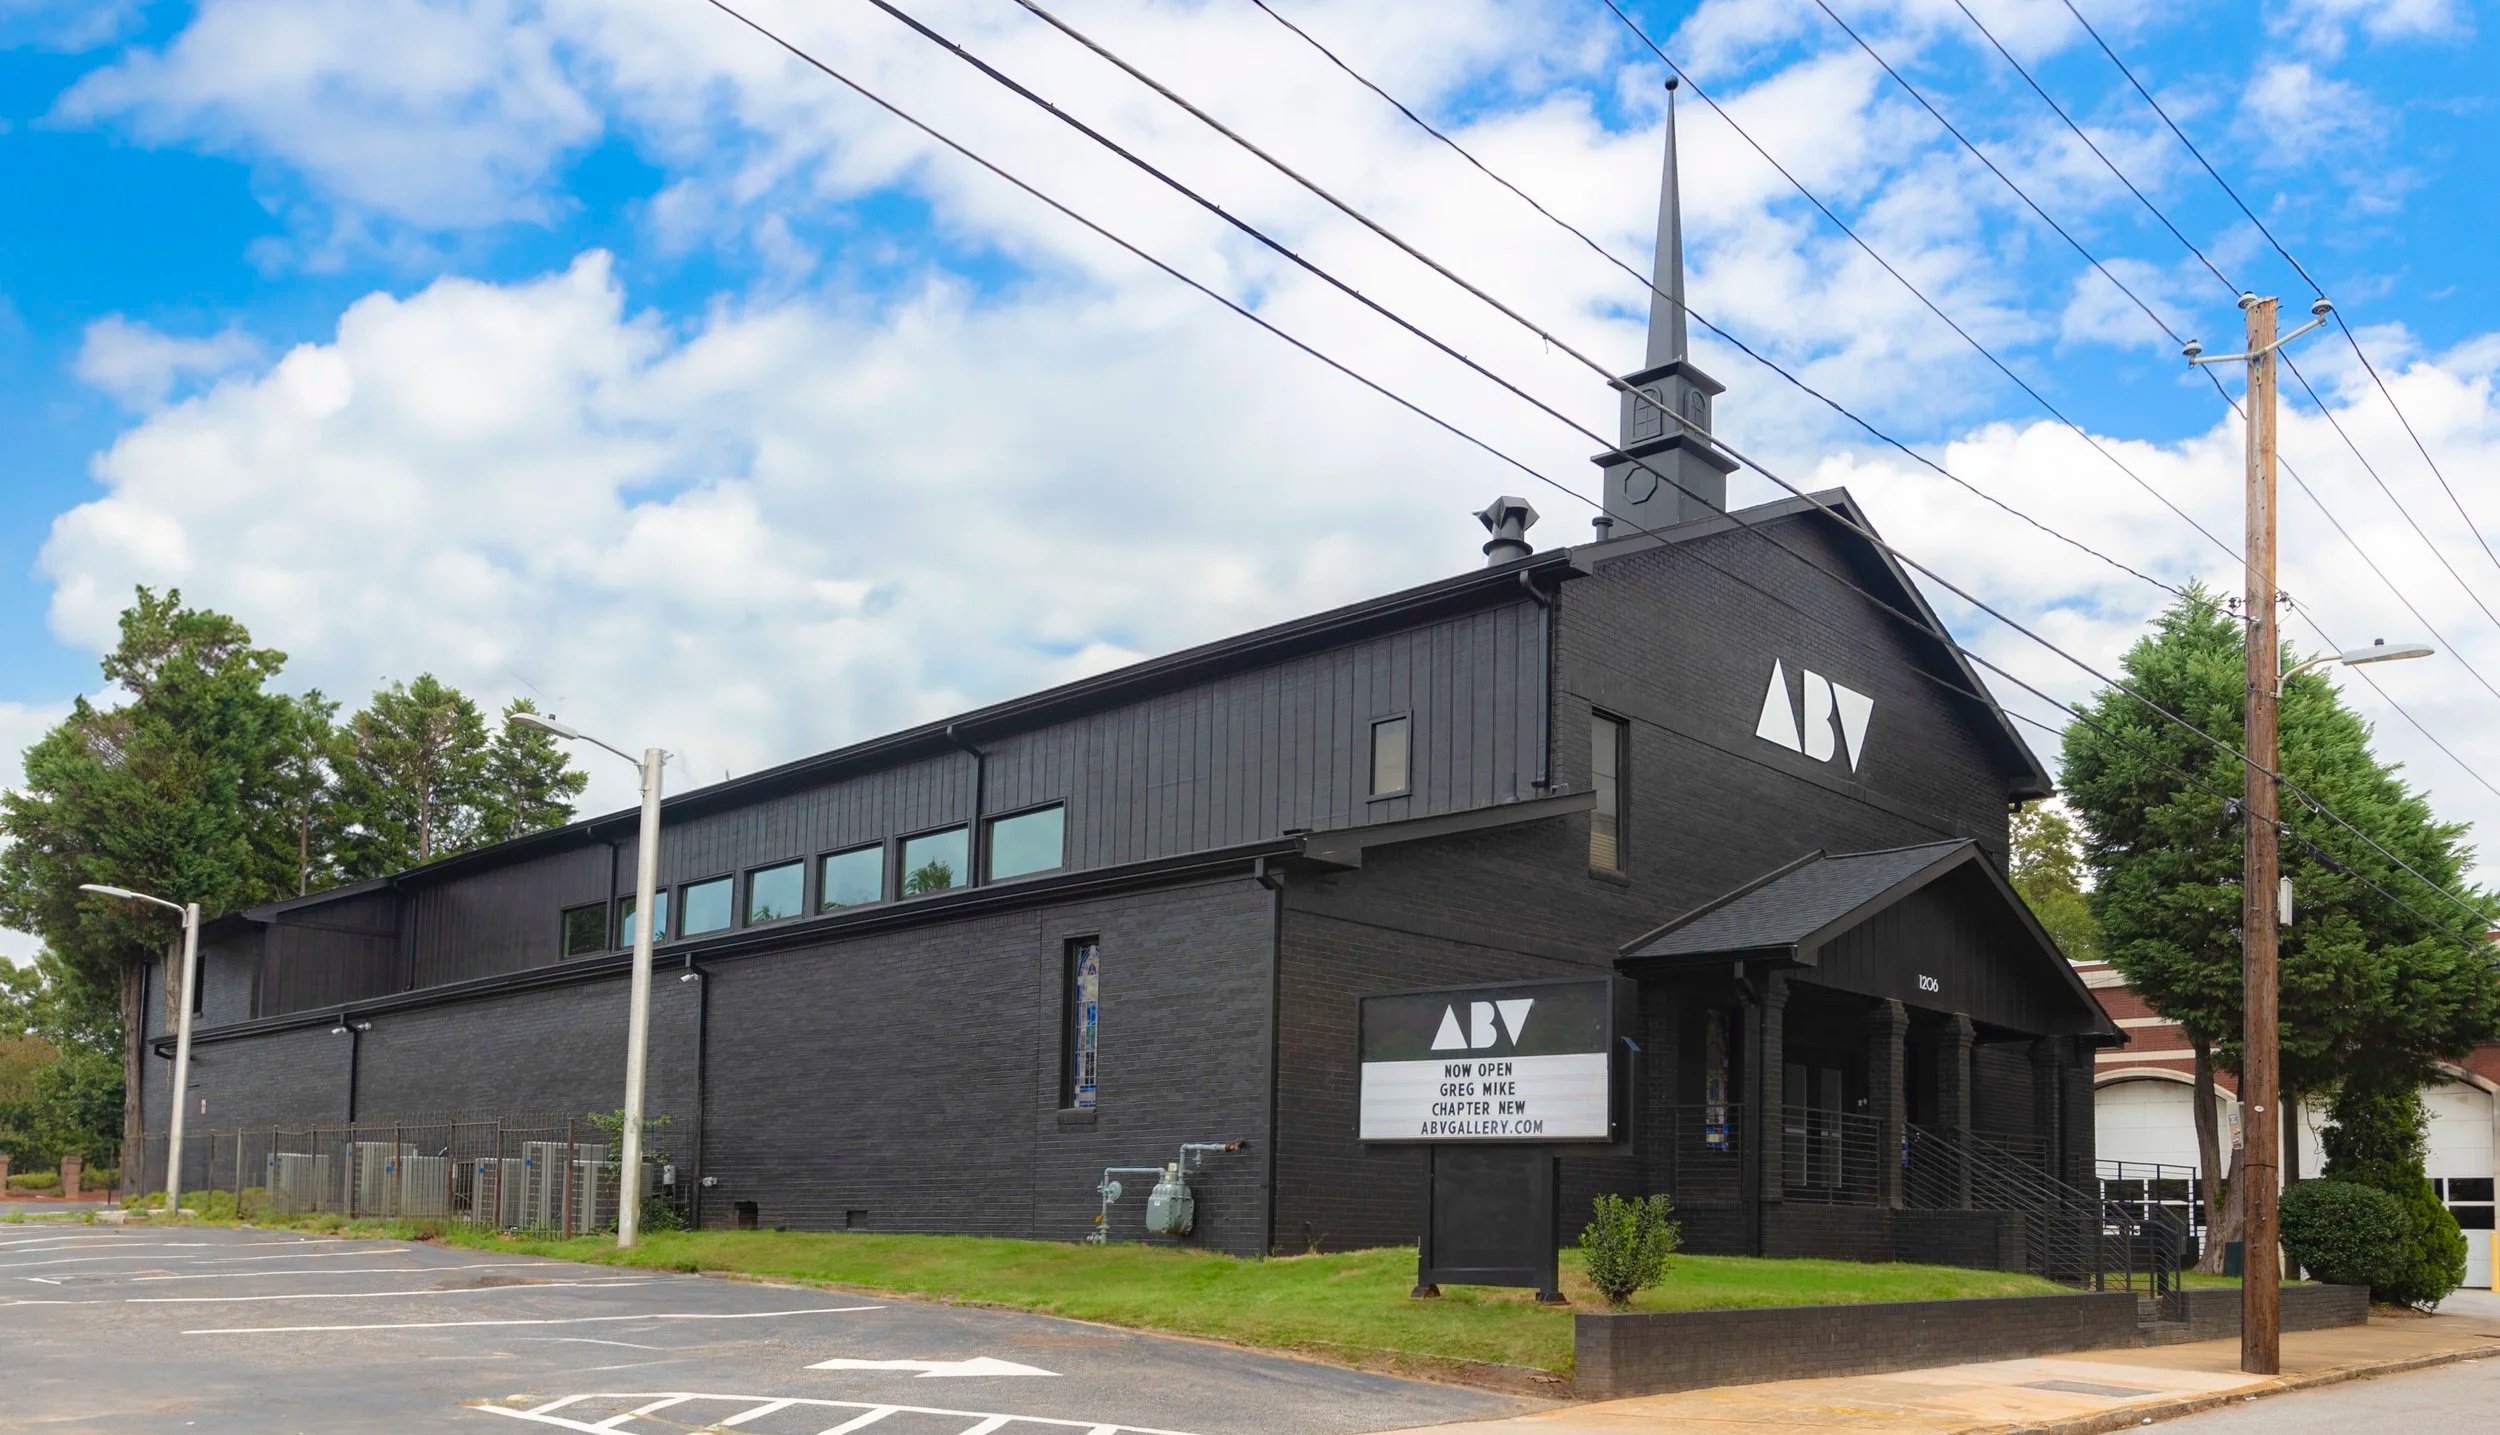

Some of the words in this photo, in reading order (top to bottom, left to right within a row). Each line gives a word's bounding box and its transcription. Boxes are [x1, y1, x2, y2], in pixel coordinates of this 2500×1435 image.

[1755, 657, 1874, 774] ABV
[1919, 974, 1939, 992] 1206
[1430, 998, 1534, 1050] ABV
[1444, 1063, 1472, 1078] NOW
[1478, 1062, 1512, 1077] OPEN
[1440, 1082, 1475, 1097] GREG
[1483, 1081, 1516, 1096] MIKE
[1432, 1102, 1490, 1116] CHAPTER
[1498, 1101, 1526, 1115] NEW
[1421, 1119, 1543, 1135] ABVGALLERY.COM
